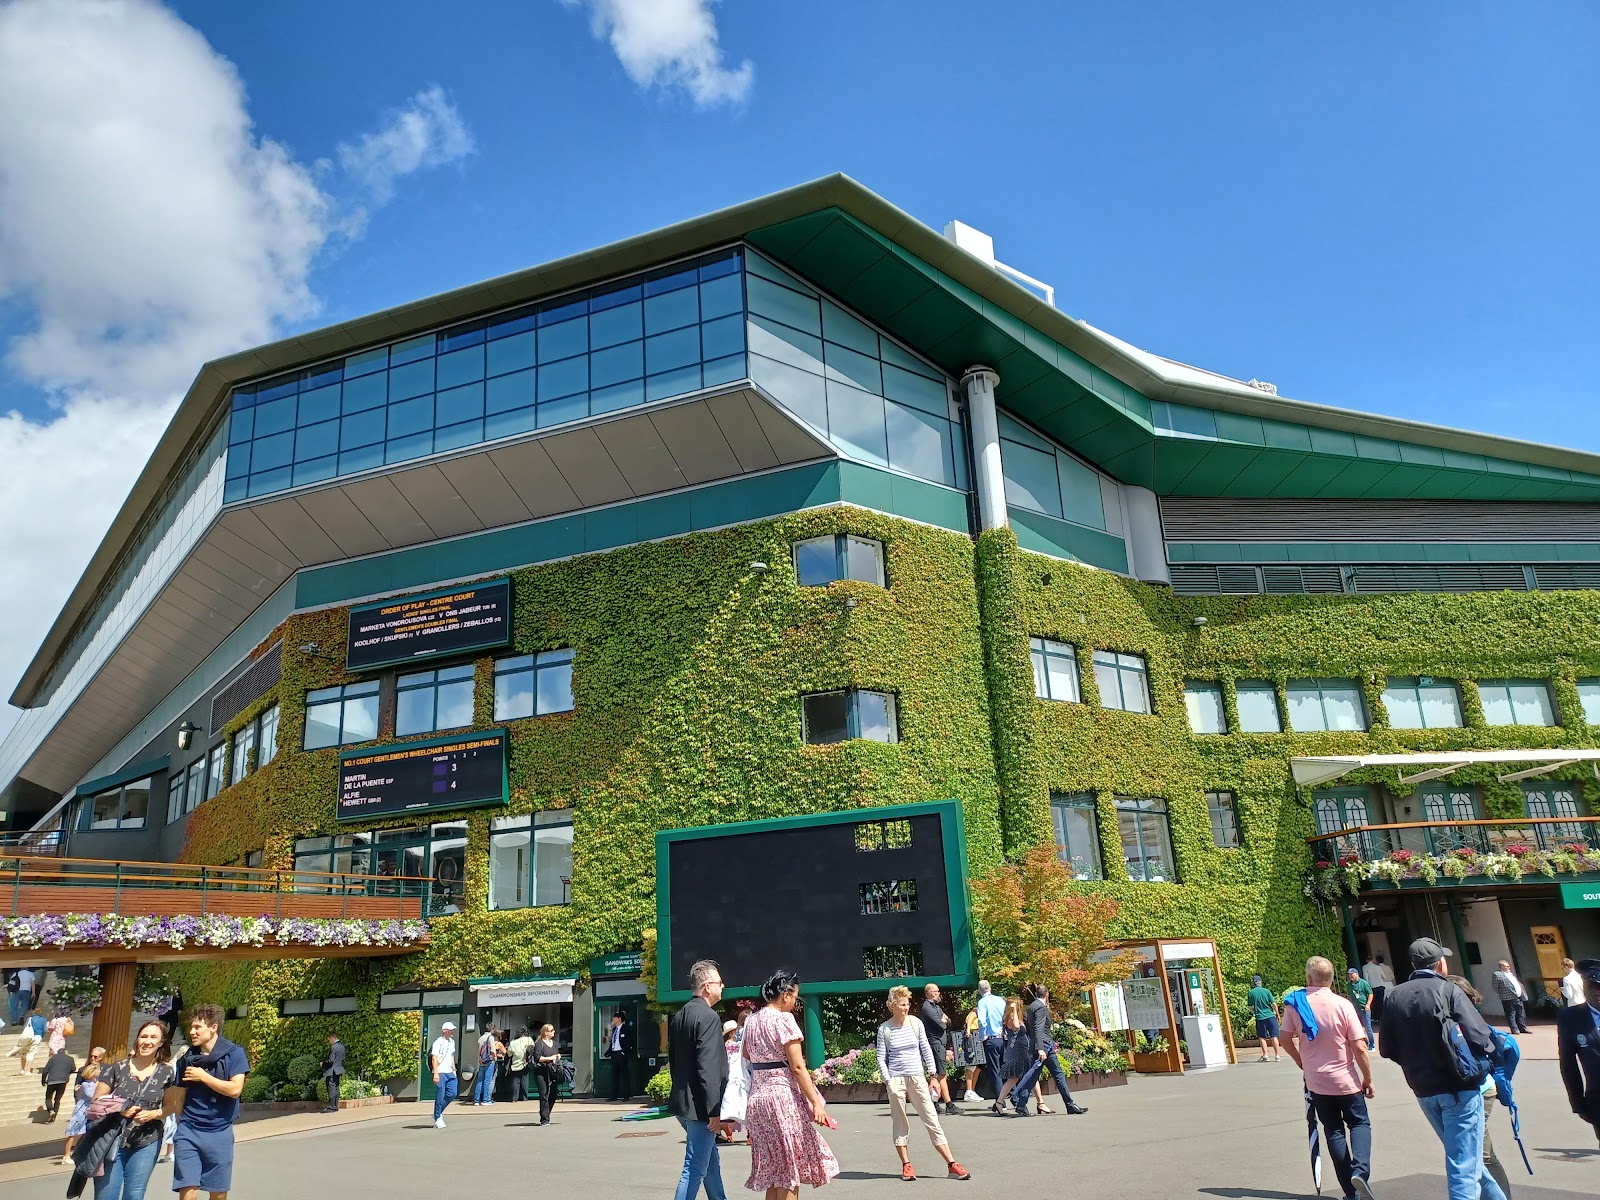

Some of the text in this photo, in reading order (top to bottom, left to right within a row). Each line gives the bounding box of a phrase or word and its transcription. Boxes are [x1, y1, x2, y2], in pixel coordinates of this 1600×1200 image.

[381, 606, 401, 615] ORDER
[411, 602, 426, 610] PLAY
[430, 597, 453, 606] CENTRE
[454, 592, 475, 602] COURT
[360, 623, 385, 632] MARKETA
[386, 616, 427, 628] VONDROUSOVA
[445, 609, 458, 617] ONS
[458, 604, 481, 614] JABEUR
[424, 620, 446, 629] DOUBLES
[354, 637, 381, 647] KOOLHOF
[384, 633, 408, 642] SKUPSKI
[422, 622, 460, 635] GRANOLLERS
[463, 616, 494, 629] ZEBALLOS
[356, 757, 373, 765] COURT
[373, 751, 408, 763] GENTLEMEN'S
[409, 747, 443, 757] WHEELCHAIR
[444, 743, 466, 753] SINGLES
[466, 739, 499, 749] SEMI-FINALS
[451, 763, 457, 771] 3
[344, 774, 367, 782] MARTIN
[353, 781, 361, 789] LA
[361, 778, 385, 787] PUENTE
[450, 780, 457, 789] 4
[343, 791, 360, 800] ALFIE
[342, 798, 367, 807] HEWETT
[488, 989, 560, 999] CHAMPIONSHIPS INFORMATION
